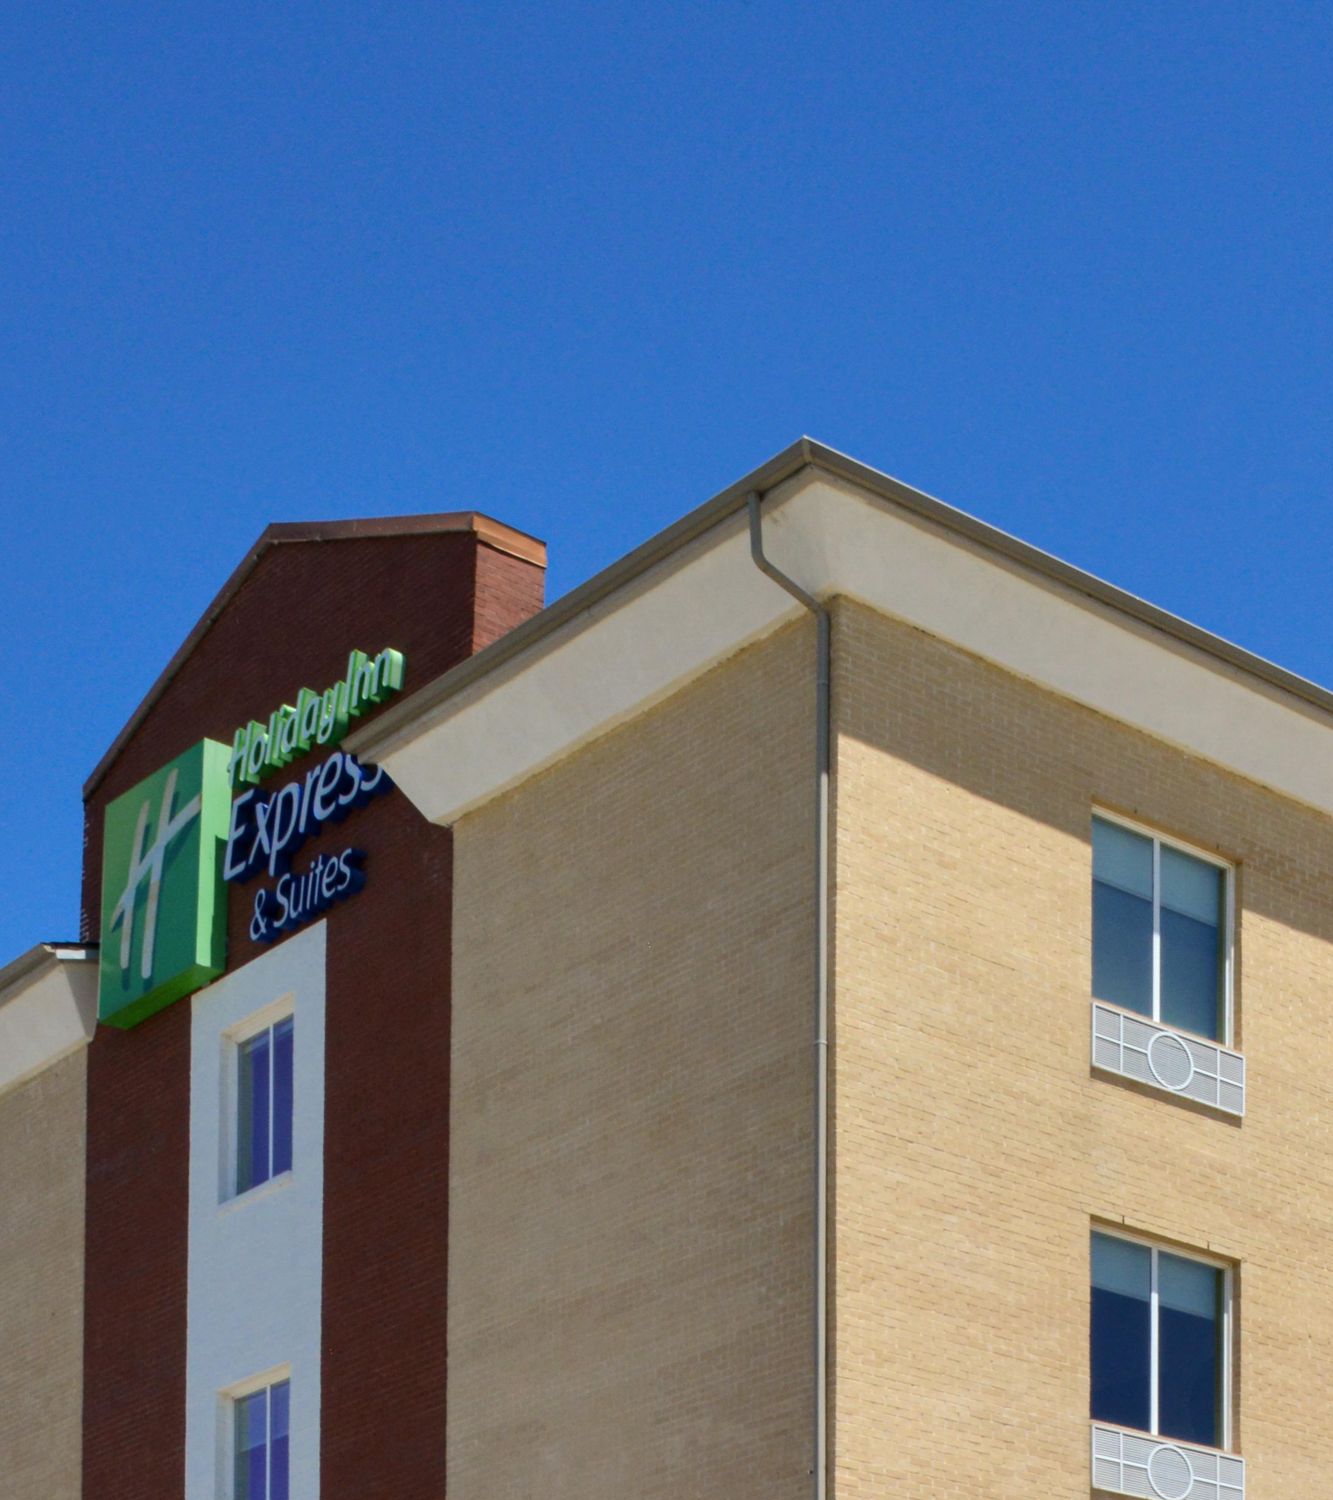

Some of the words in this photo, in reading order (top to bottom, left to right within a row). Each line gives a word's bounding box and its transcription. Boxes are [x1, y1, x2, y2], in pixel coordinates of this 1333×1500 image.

[227, 682, 347, 788] Holiday
[343, 648, 405, 716] Inn
[250, 888, 267, 942] &
[273, 848, 353, 929] Suites
